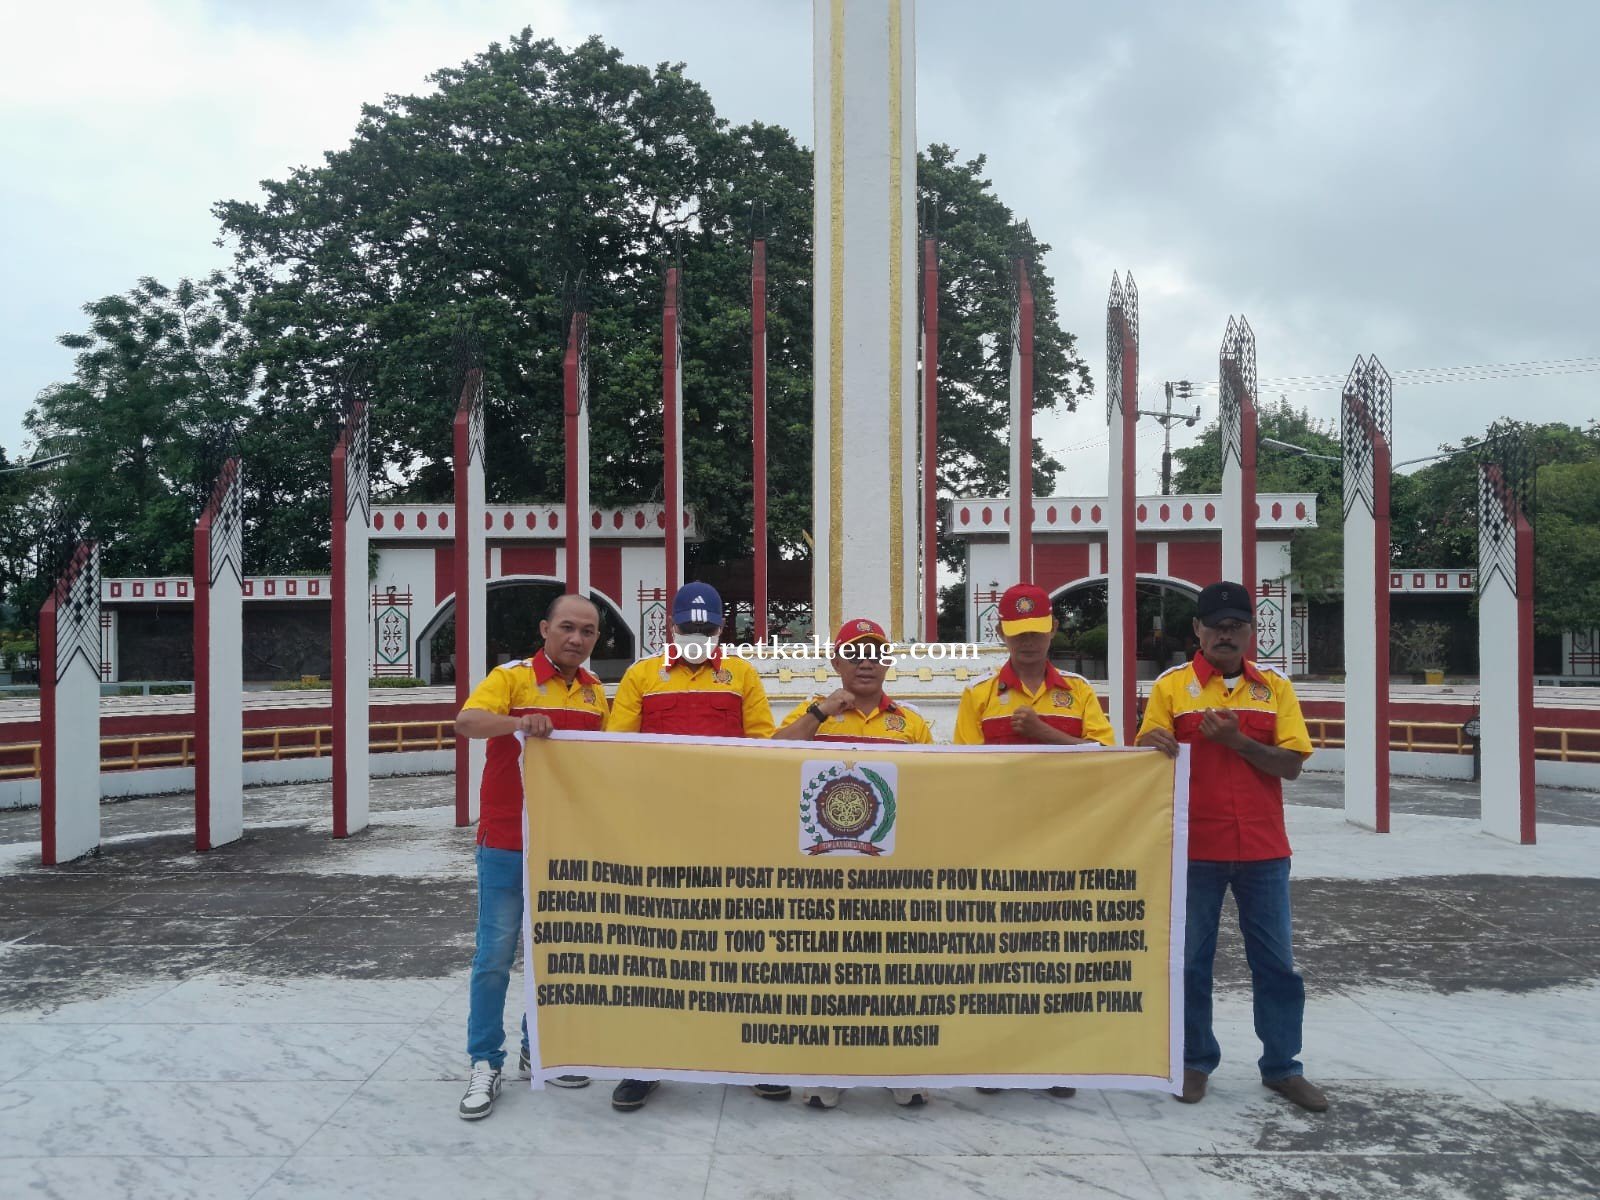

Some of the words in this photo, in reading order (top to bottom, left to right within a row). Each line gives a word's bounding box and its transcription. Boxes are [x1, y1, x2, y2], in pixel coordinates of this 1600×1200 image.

[549, 860, 587, 881] KAMI
[593, 861, 643, 885] DEWAN
[647, 866, 722, 888] PIMPINAN
[726, 867, 773, 888] PUSAT
[777, 868, 843, 889] PENYANG
[848, 869, 933, 890] SAHAWUNG
[937, 869, 977, 890] PROV
[982, 869, 1075, 891] KALIMANTAN
[1079, 870, 1136, 890] TENGAH
[538, 891, 596, 913] DENGAN
[601, 894, 620, 913] INI
[625, 896, 721, 919] MENYATAKAN
[725, 898, 784, 920] DENGAN
[788, 899, 835, 920] TEGAS
[839, 899, 906, 921] MENARIK
[911, 900, 942, 921] DIRI
[946, 900, 996, 922] UNTUK
[1001, 900, 1092, 922] MENDUKUNG
[1097, 900, 1145, 921] KASUS
[534, 922, 603, 944] SAUDARA
[607, 924, 677, 949] PRIYATNO
[681, 929, 717, 951] ATAU
[725, 931, 765, 952] TONO
[843, 931, 881, 953] KAMI
[886, 932, 995, 953] MENDAPATKAN
[1000, 932, 1059, 953] SUMBER
[1064, 930, 1148, 953] INFORMASI,
[548, 953, 585, 975] DATA
[589, 954, 619, 975] DAN
[623, 955, 666, 979] FAKTA
[670, 960, 705, 981] DARI
[710, 962, 737, 982] TIM
[742, 962, 830, 984] KECAMATAN
[835, 963, 881, 984] SERTA
[885, 964, 975, 984] MELAKUKAN
[979, 962, 1071, 984] INVESTIGASI
[1075, 961, 1131, 983] DENGAN
[689, 991, 782, 1014] PERNYATAAN
[786, 995, 806, 1015] INI
[959, 993, 1040, 1014] PERHATIAN
[1044, 993, 1093, 1013] SEMUA
[1097, 991, 1142, 1013] PIHAK
[742, 1024, 829, 1046] DIUCAPKAN
[833, 1025, 889, 1046] TERIMA
[893, 1025, 939, 1046] KASIH
